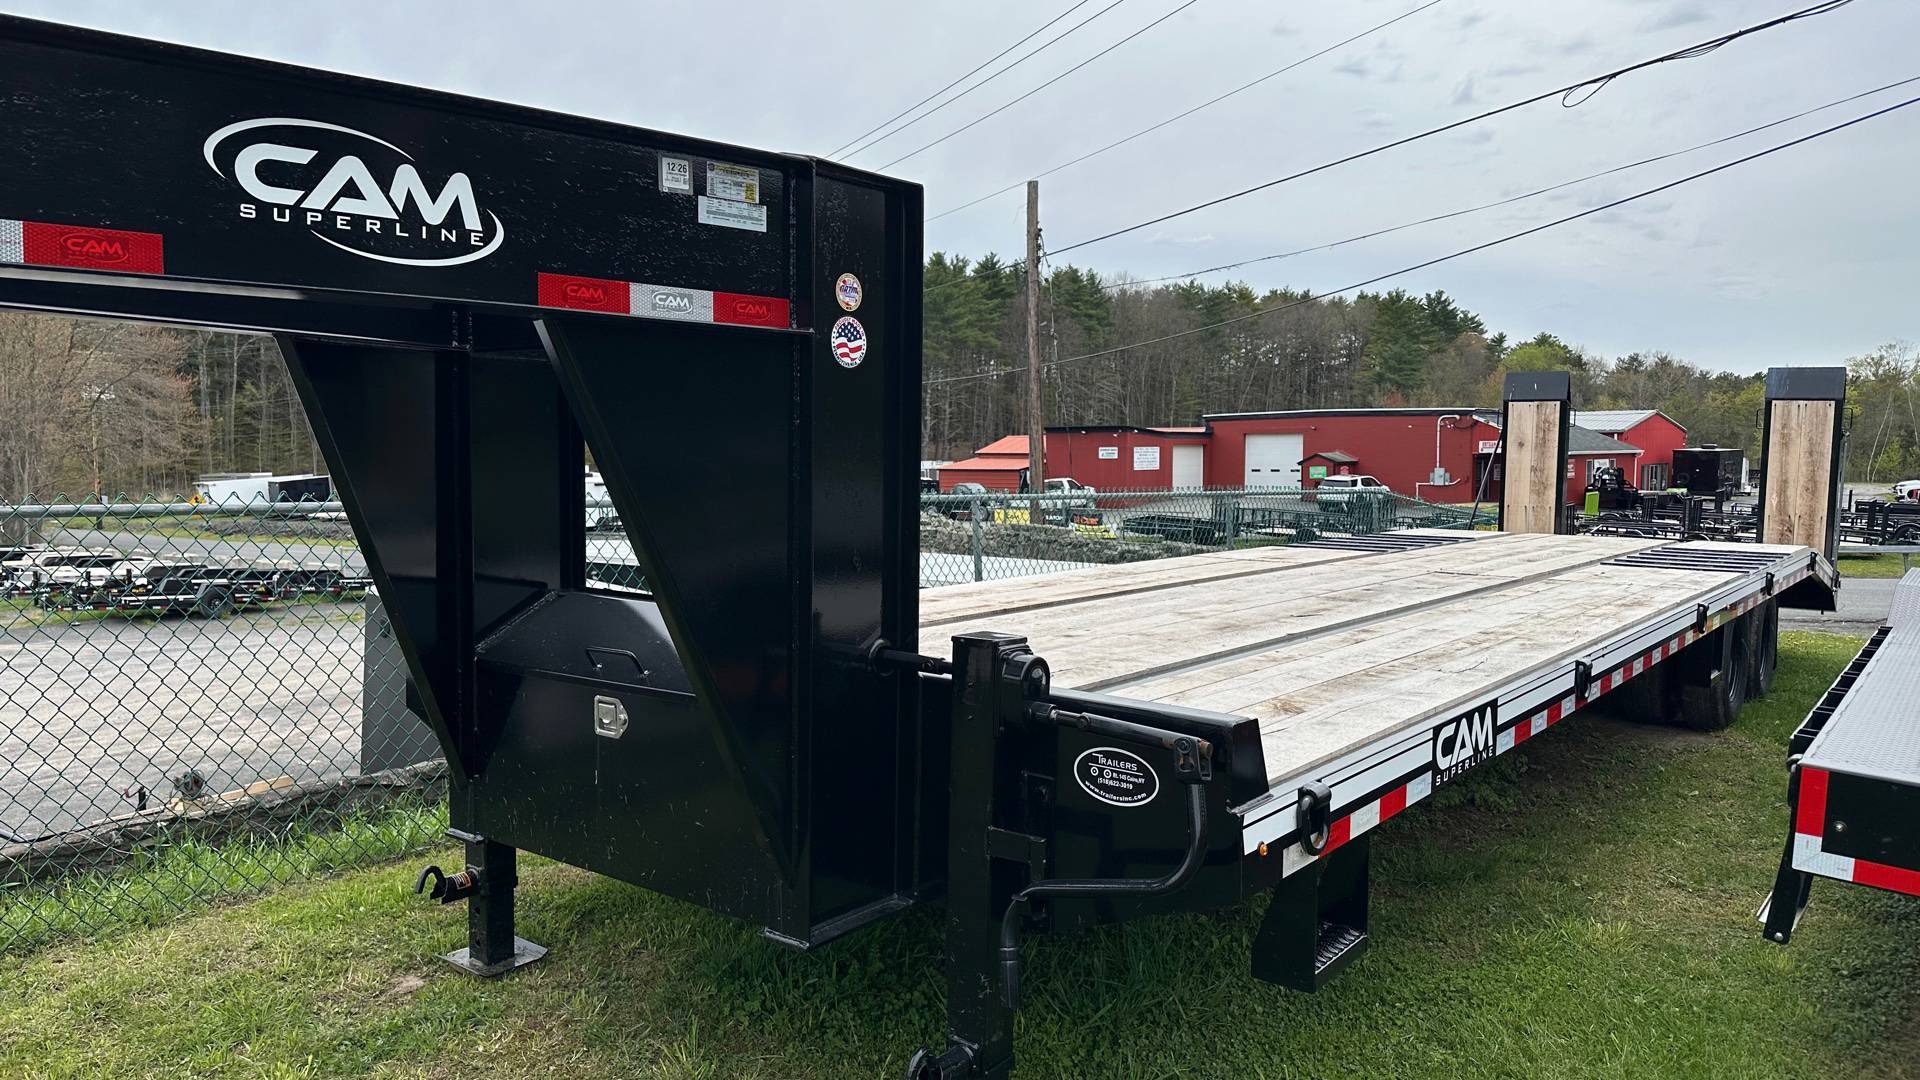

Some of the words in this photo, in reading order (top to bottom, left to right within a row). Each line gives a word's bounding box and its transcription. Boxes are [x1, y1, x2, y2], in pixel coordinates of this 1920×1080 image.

[667, 162, 676, 172] 12
[678, 163, 688, 174] 26
[234, 142, 483, 232] CAM
[239, 203, 485, 246] SUPERLINE
[66, 238, 124, 256] CAM
[566, 285, 604, 300] CAM
[655, 294, 690, 310] CAM
[736, 302, 768, 316] CAM
[1436, 706, 1494, 770] CAM
[1435, 746, 1494, 786] SUPERLINE
